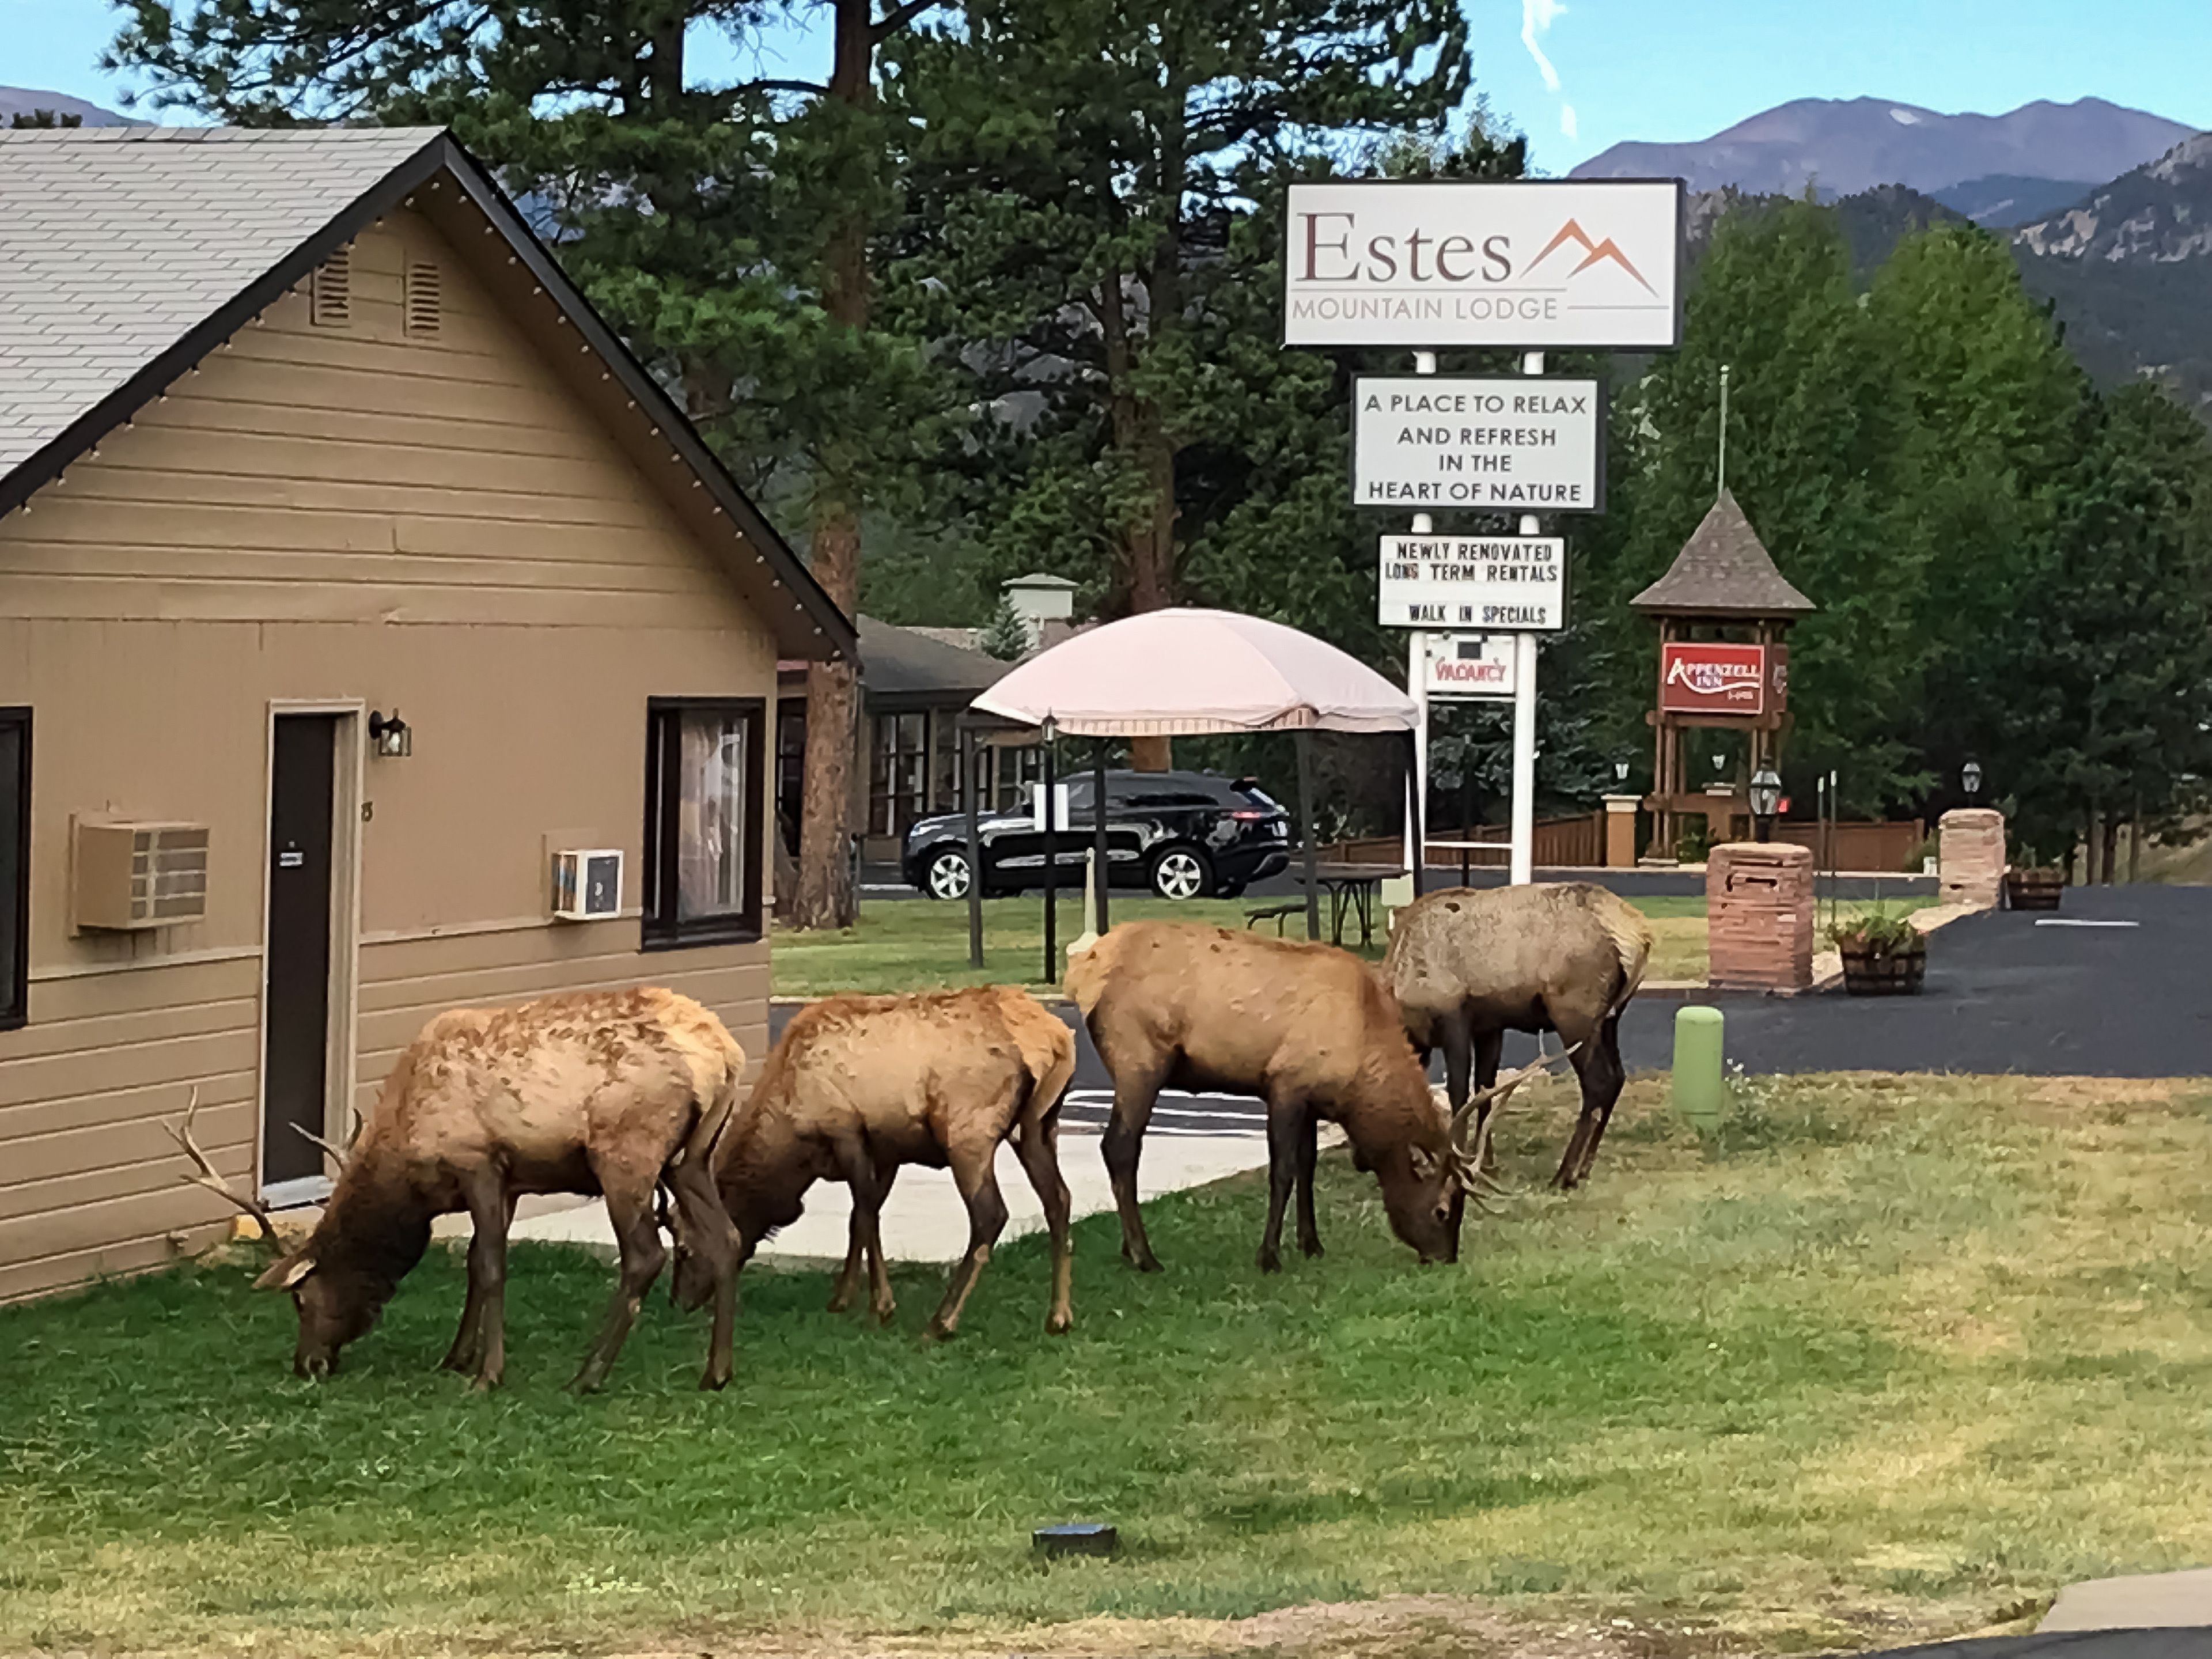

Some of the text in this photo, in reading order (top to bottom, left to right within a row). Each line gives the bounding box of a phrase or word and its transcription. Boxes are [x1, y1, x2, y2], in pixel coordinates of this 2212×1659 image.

[1294, 212, 1513, 282] Estes
[1292, 297, 1558, 320] MOUNTAIN LODGE
[1365, 394, 1586, 415] A PLACE TO RELAX
[1397, 427, 1556, 446] AND REFRESH
[1439, 454, 1512, 472] IN THE
[1369, 482, 1581, 501] HEART OF NATURE
[1397, 543, 1552, 560] NEWLY RENOVATED
[1430, 563, 1475, 581] TERM
[1487, 565, 1557, 582] RENTALS
[1410, 604, 1546, 624] WALK IN SPECIALS
[1435, 662, 1506, 681] VACANCY
